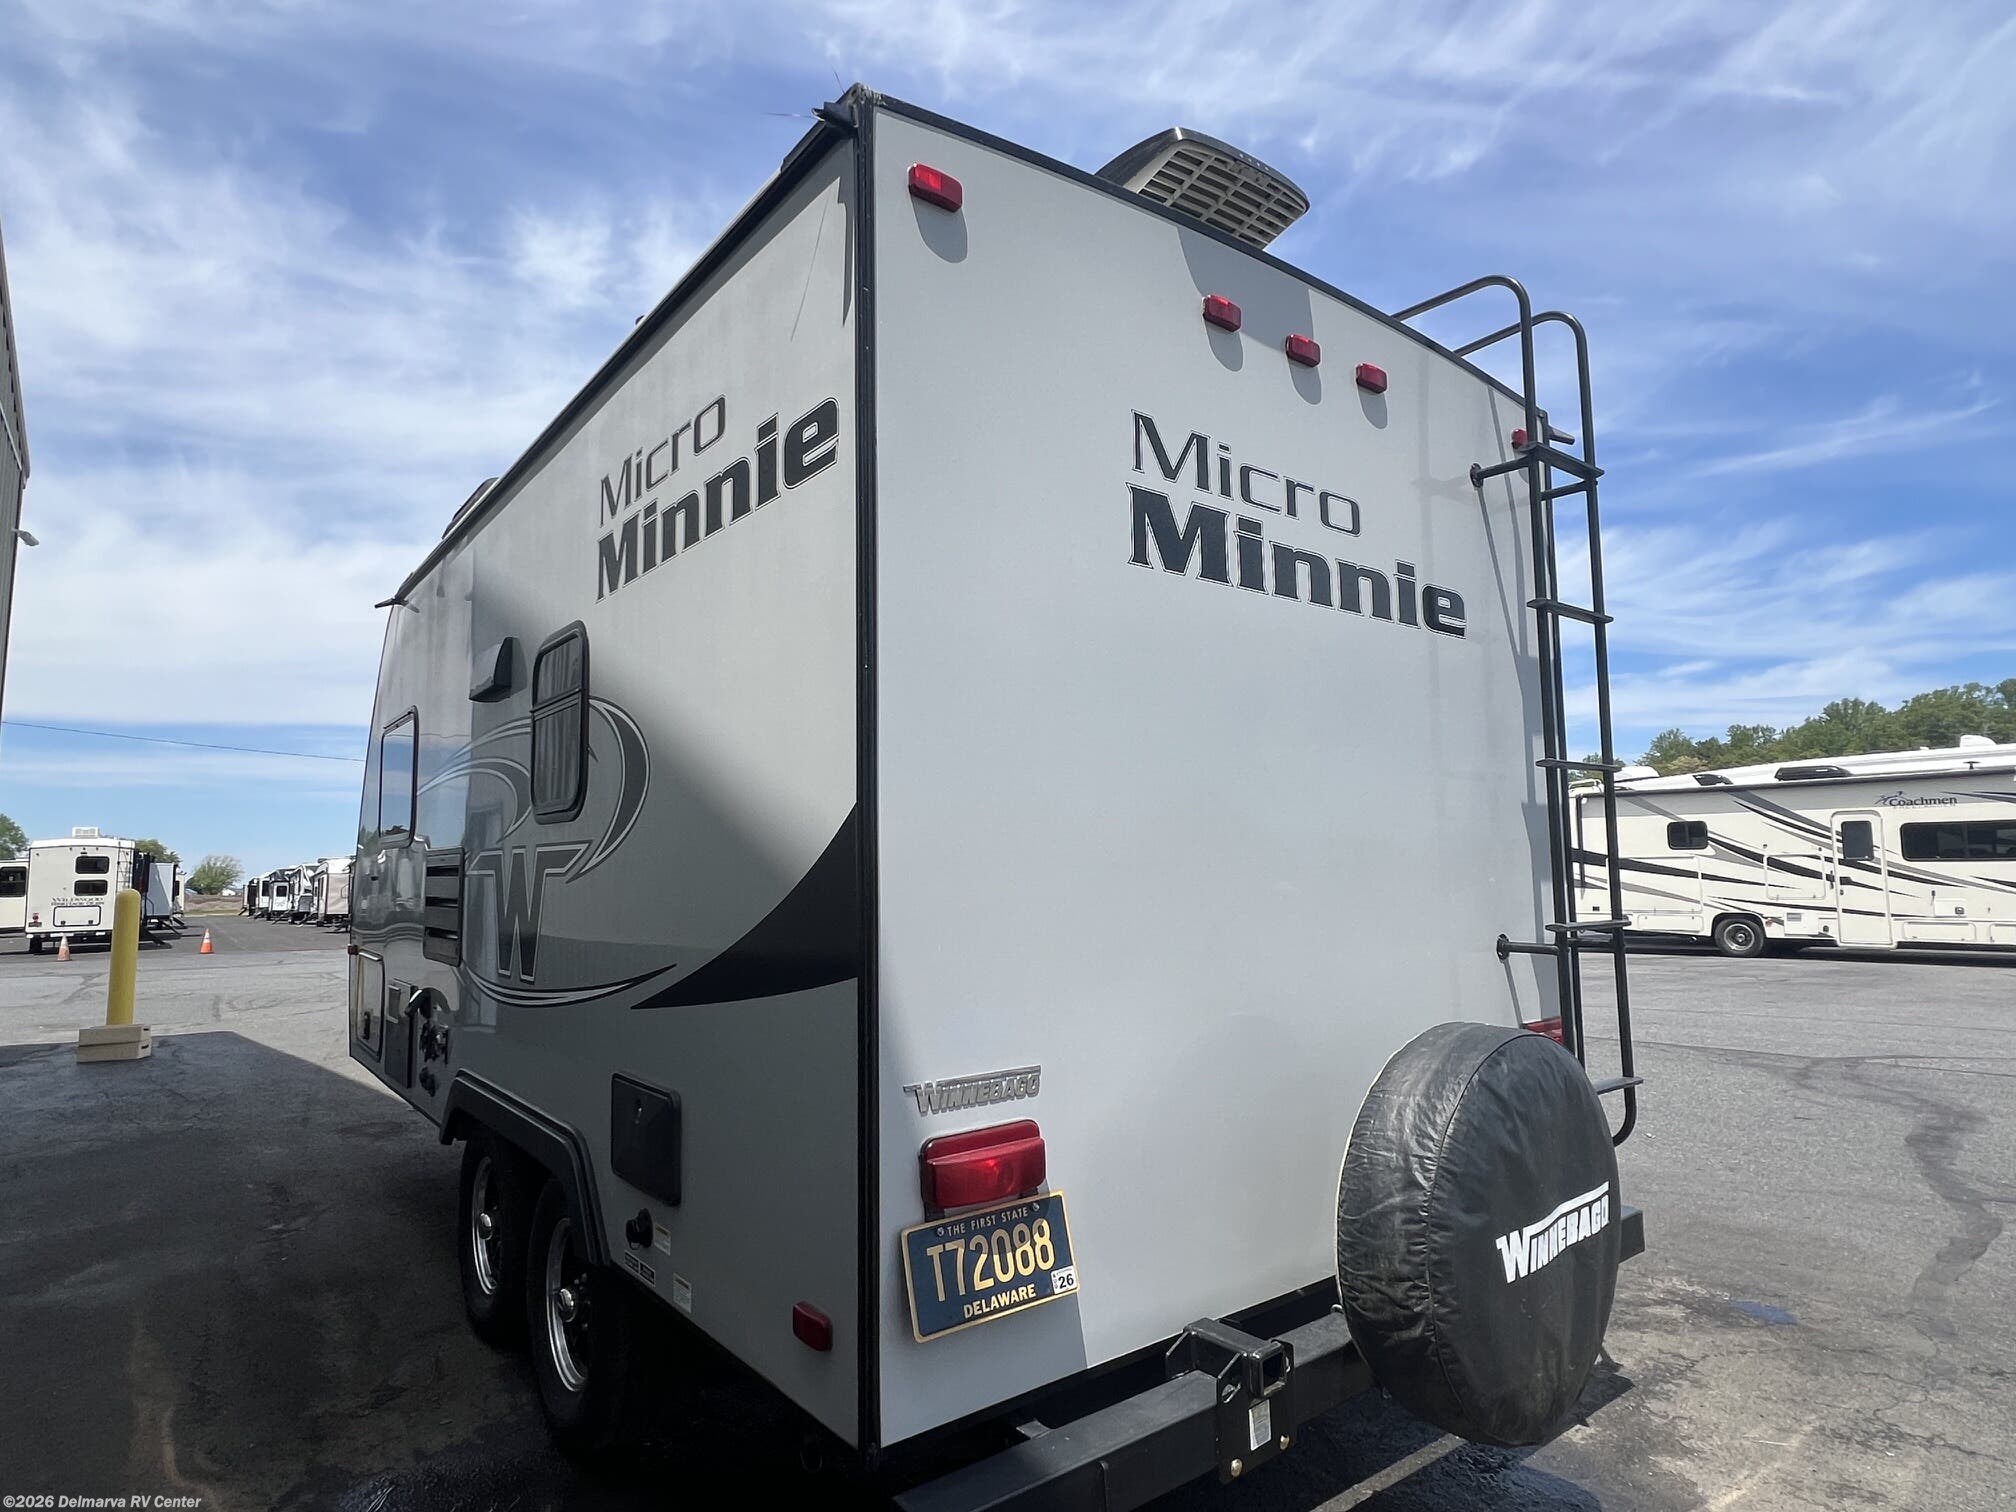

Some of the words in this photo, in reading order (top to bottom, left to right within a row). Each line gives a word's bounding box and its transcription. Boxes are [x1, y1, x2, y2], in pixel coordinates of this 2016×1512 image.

[596, 397, 840, 604] Minnie
[600, 394, 726, 528] Micro
[1131, 409, 1361, 537] Micro
[1125, 482, 1467, 639] Minnie
[1889, 797, 1958, 807] Coachmen
[903, 1065, 1041, 1117] WINNEBAGO
[926, 1218, 1056, 1302] T72088
[947, 1223, 966, 1236] THE
[970, 1214, 998, 1230] FIRST
[1001, 1207, 1029, 1224] STATE
[1495, 1181, 1610, 1284] WINNEBAGO
[963, 1284, 1037, 1319] DELAWARE
[1058, 1273, 1074, 1289] 26
